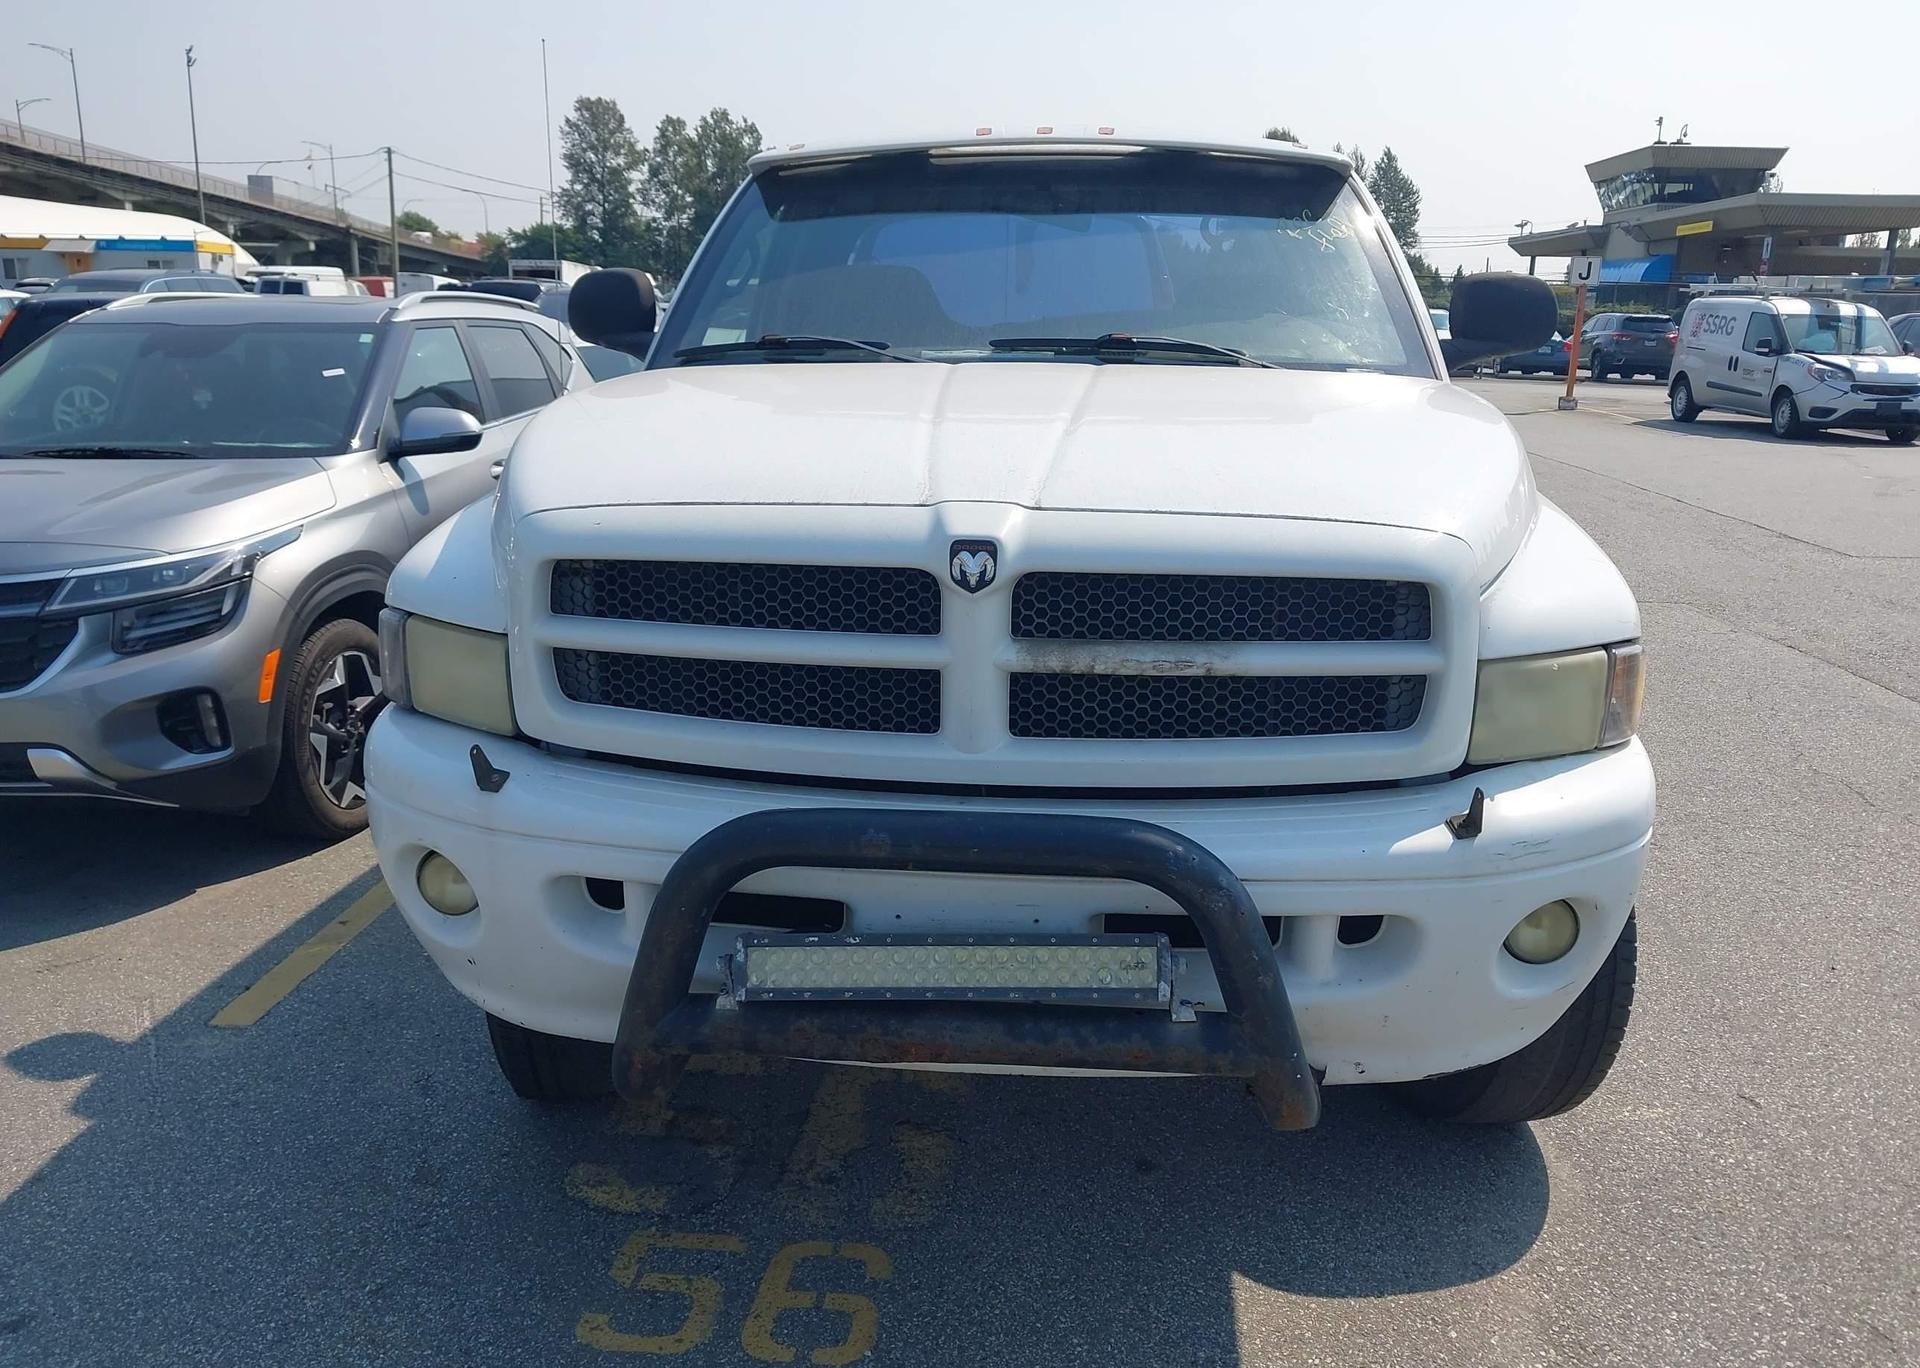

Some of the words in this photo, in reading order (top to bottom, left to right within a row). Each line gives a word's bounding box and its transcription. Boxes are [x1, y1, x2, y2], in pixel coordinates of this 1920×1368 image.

[1578, 261, 1593, 281] J
[1703, 313, 1737, 336] SSRG
[574, 1228, 894, 1367] 56
